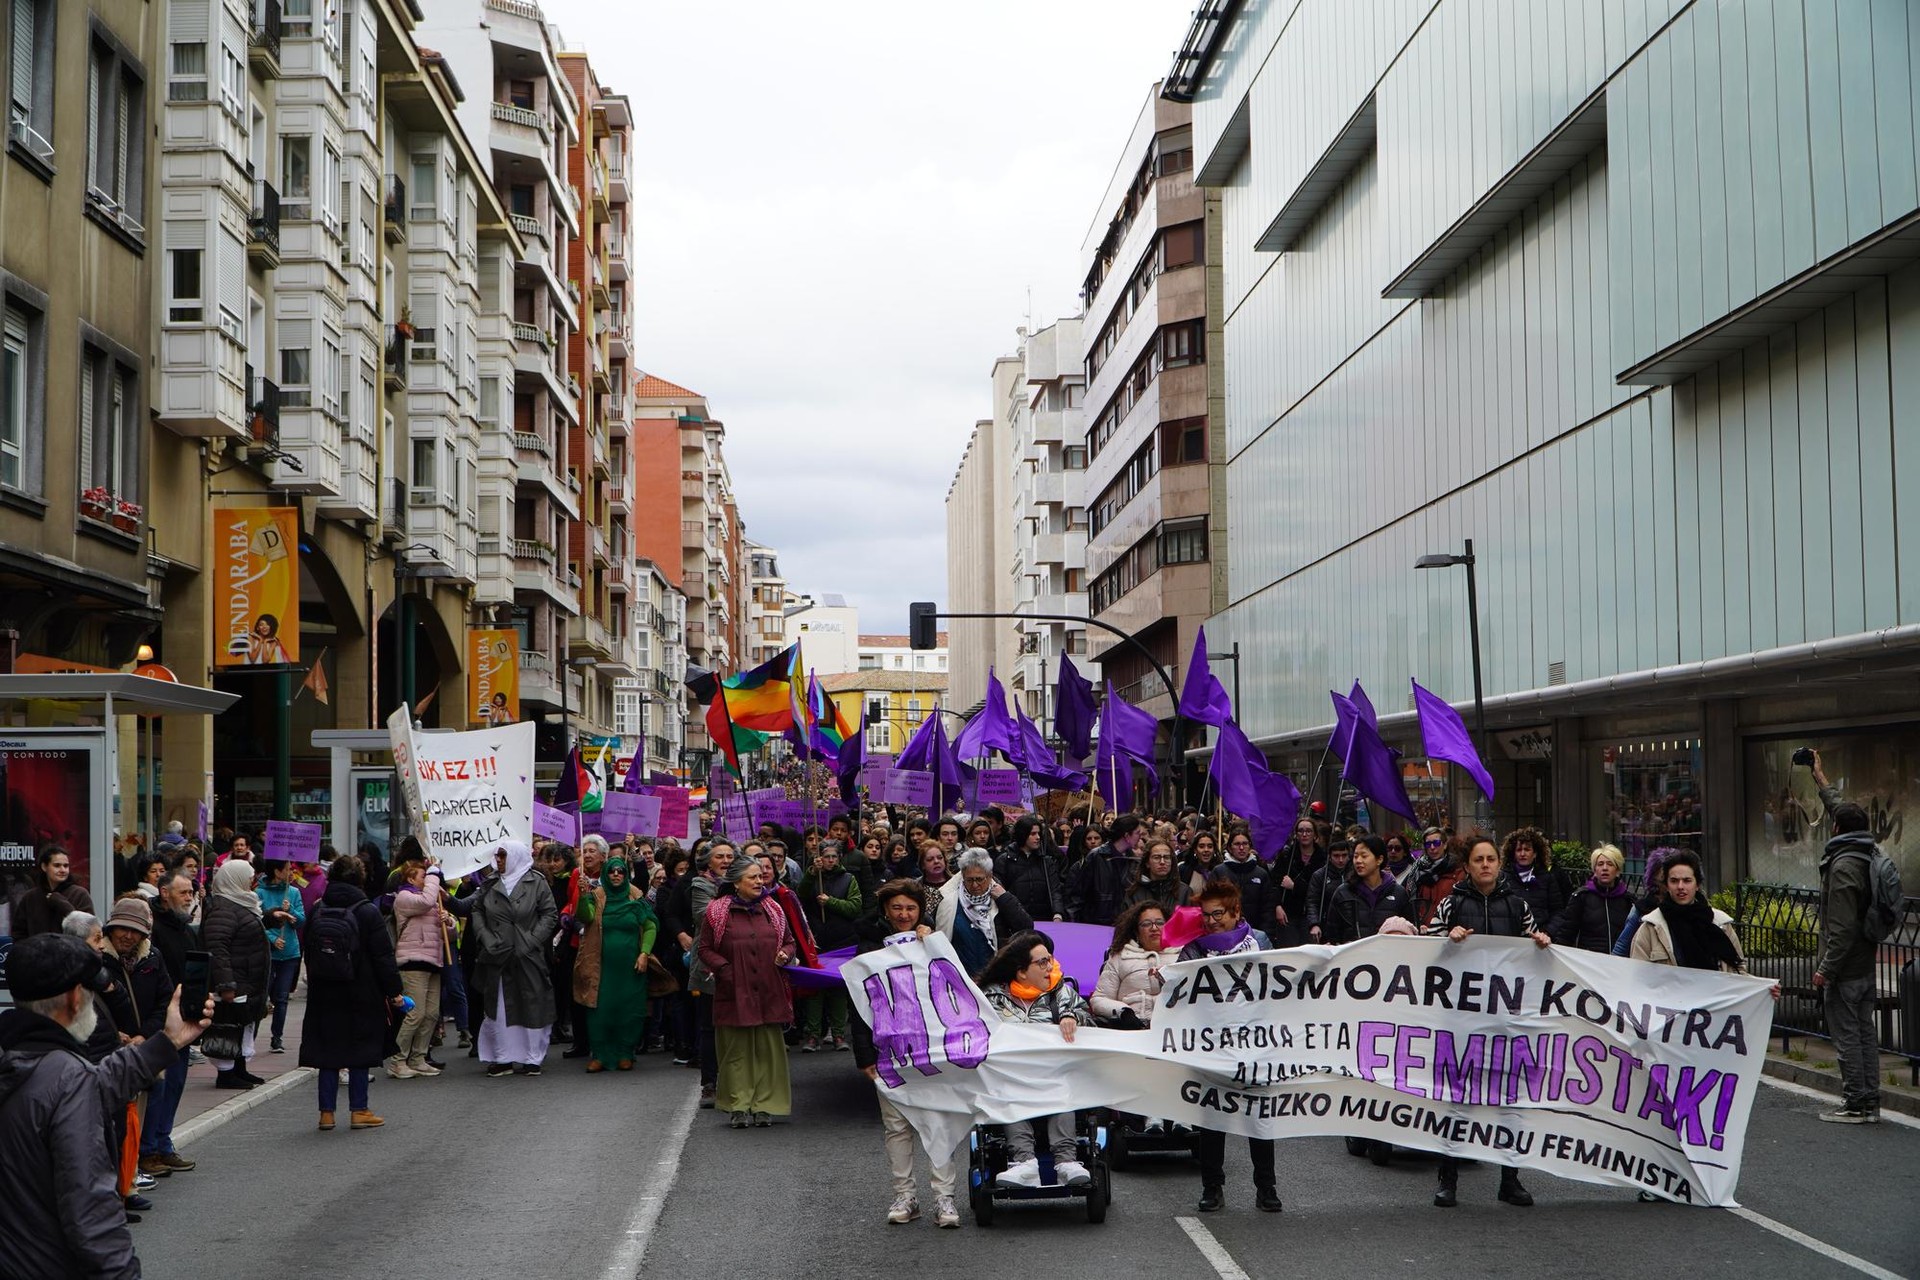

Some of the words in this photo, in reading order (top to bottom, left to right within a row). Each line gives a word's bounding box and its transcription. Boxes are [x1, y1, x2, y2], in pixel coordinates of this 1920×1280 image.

[262, 530, 279, 549] D
[228, 519, 251, 655] DENDARABA
[477, 637, 492, 717] DENDARABA
[443, 760, 469, 780] EZ
[1162, 1024, 1294, 1054] AUSARDIA
[1305, 1022, 1351, 1050] ETA
[1540, 979, 1748, 1056] KONTRA
[1356, 1020, 1739, 1152] FEMINISTAK!
[1180, 1080, 1332, 1120] GASTEIZKO
[1339, 1095, 1535, 1155] MUGIMENDU
[1540, 1133, 1692, 1204] FEMINISTA
